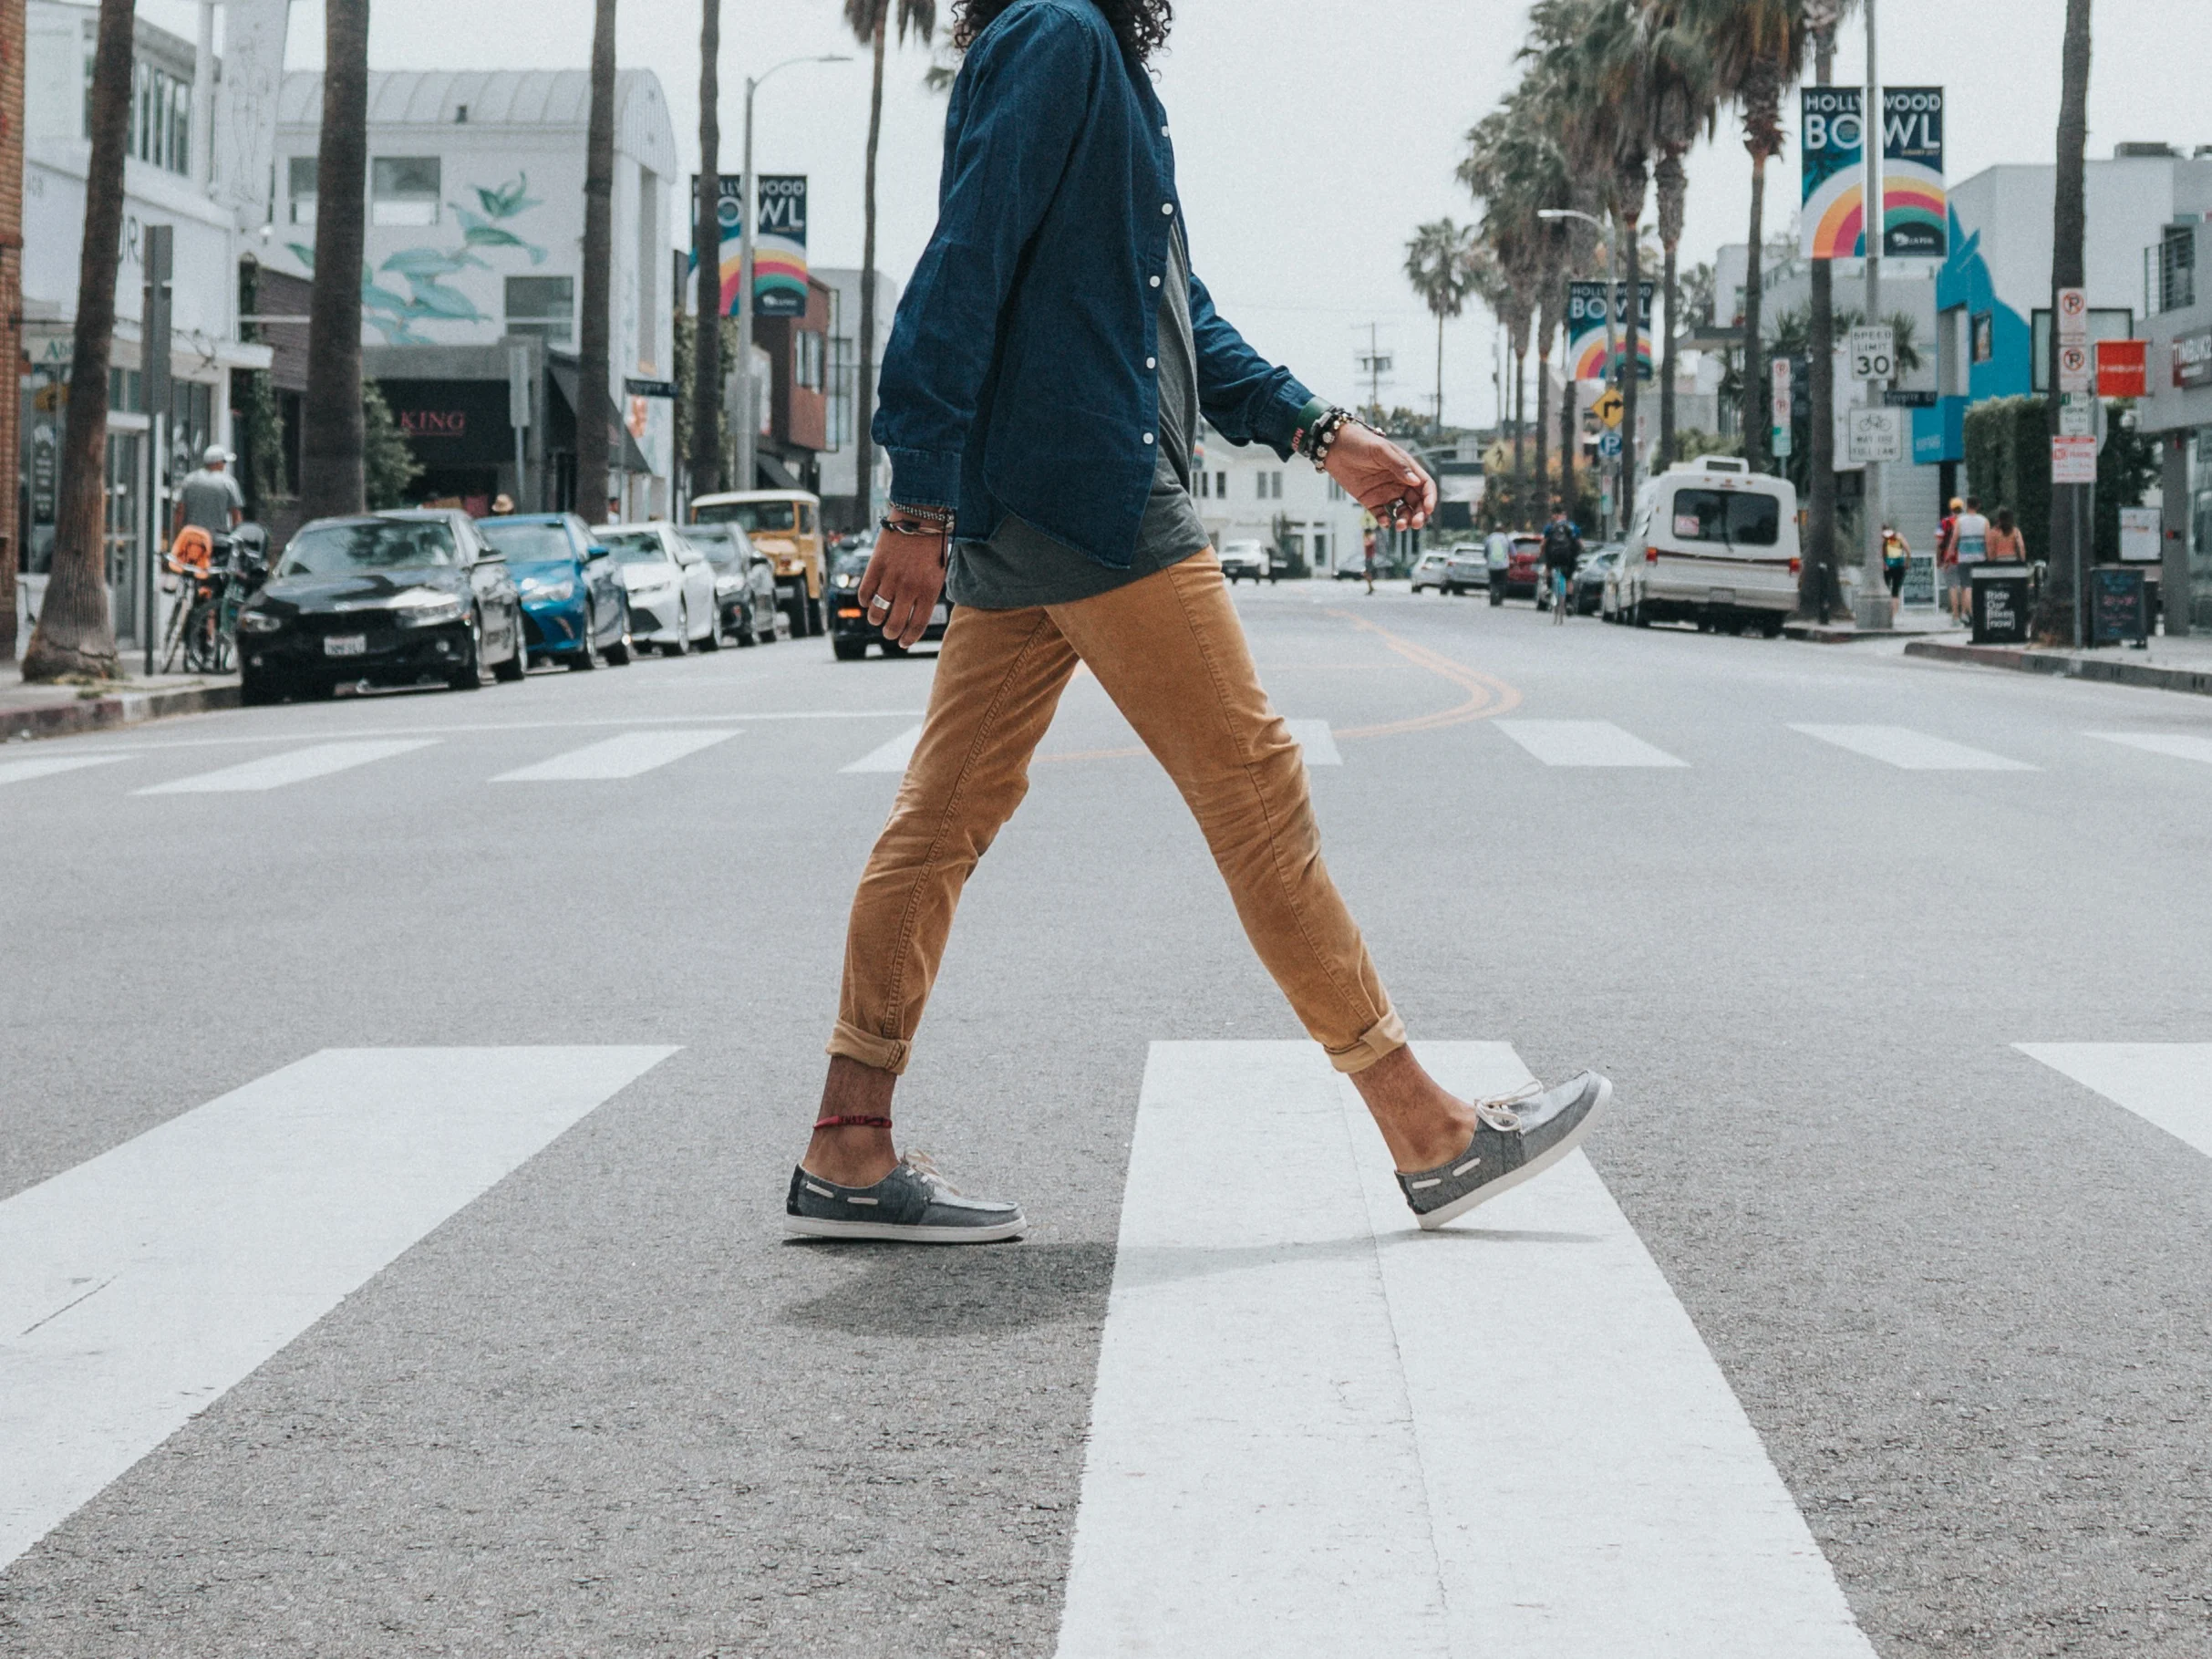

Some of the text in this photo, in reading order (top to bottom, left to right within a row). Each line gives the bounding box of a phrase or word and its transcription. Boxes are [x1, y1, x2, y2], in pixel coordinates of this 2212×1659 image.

[1854, 331, 1892, 340] SPEED
[1857, 343, 1886, 353] LIMIT
[1856, 355, 1890, 375] 30
[1986, 591, 2010, 600] Ride
